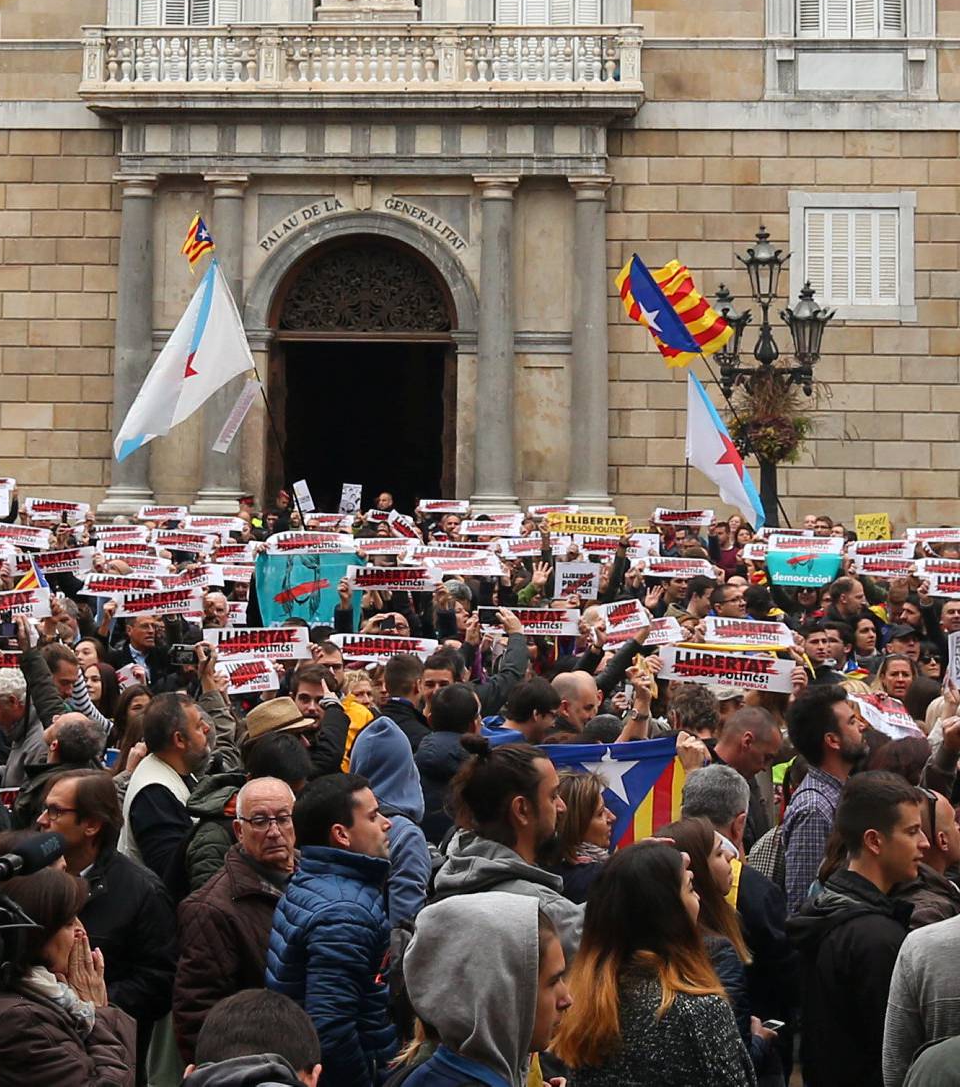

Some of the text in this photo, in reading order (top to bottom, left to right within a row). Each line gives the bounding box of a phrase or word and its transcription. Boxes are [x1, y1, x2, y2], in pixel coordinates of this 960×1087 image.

[260, 198, 467, 251] PALAU DE LA GENERALITAT
[565, 516, 624, 526] LLIBERTAT
[356, 569, 428, 581] LLIBERTAT
[124, 589, 192, 605] LLIBERTAT
[218, 629, 295, 645] LLIBERTAT
[342, 636, 422, 652] LLIBERTAT
[675, 651, 776, 673] LLIBERTAT
